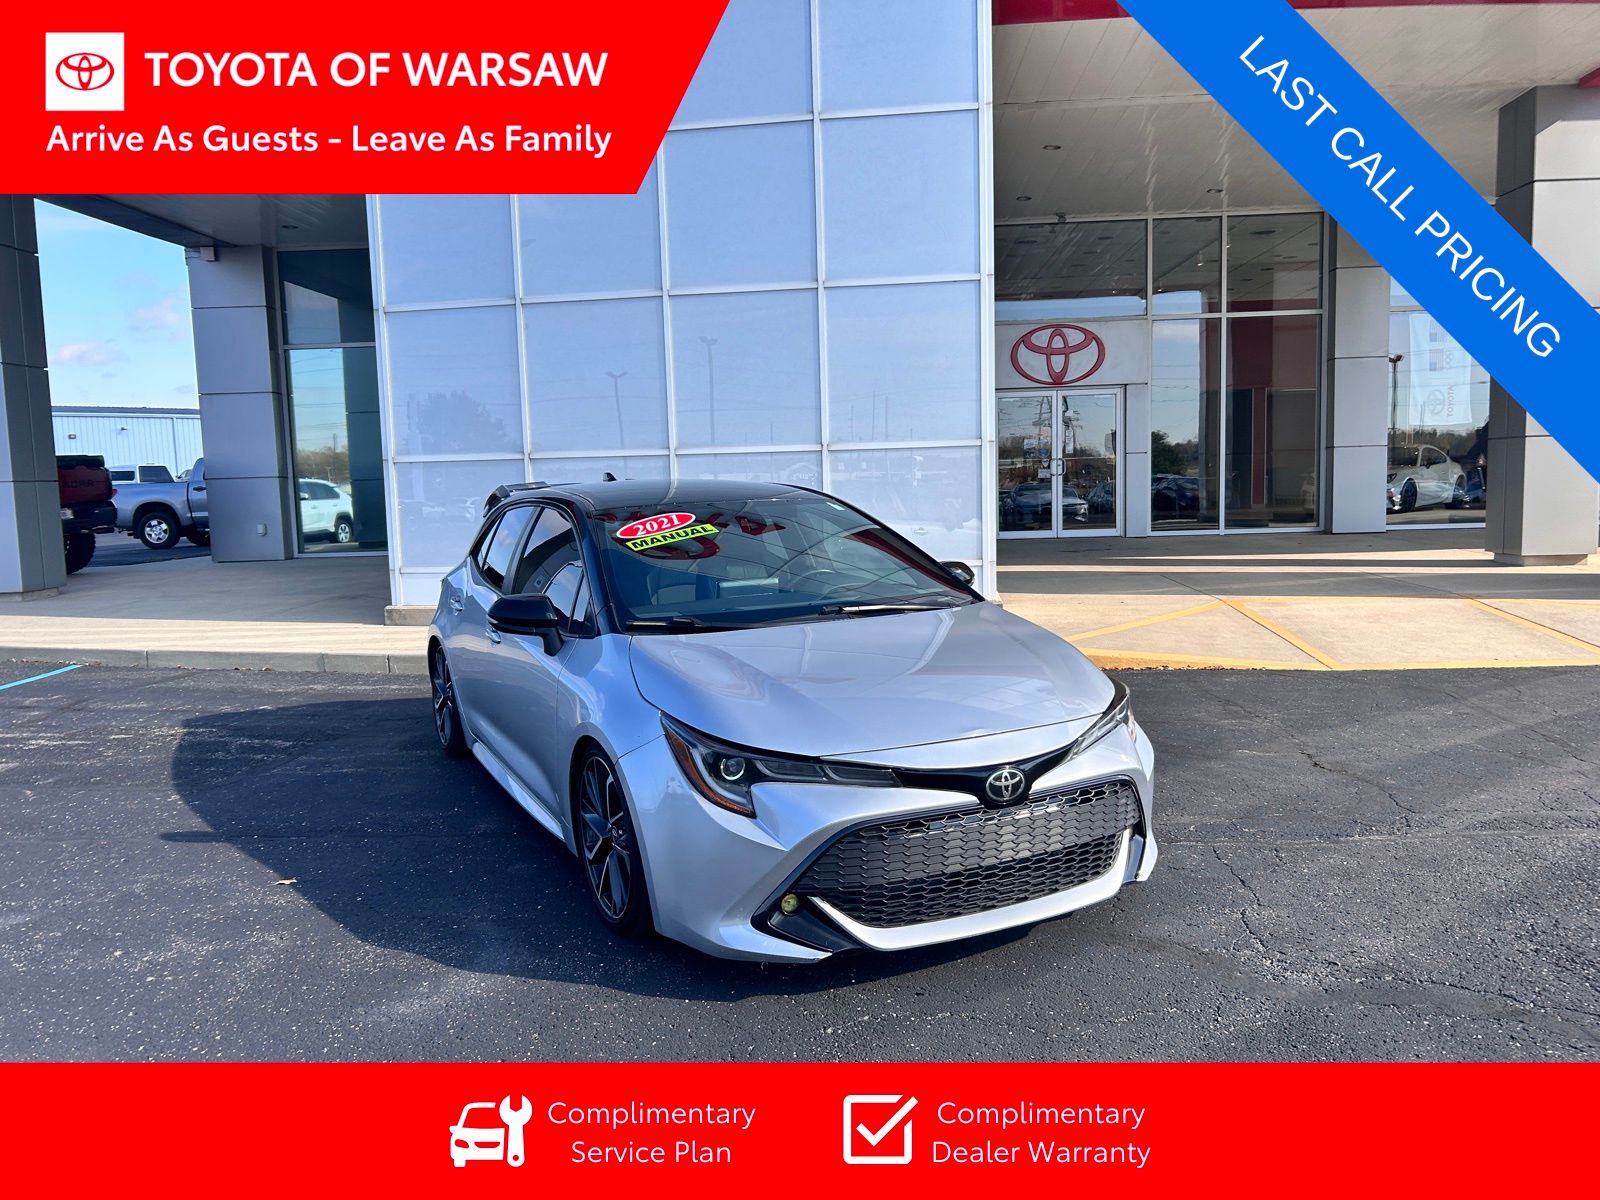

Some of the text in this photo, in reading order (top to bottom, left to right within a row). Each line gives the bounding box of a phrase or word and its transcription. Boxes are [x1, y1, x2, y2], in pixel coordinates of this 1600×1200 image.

[1447, 384, 1456, 418] TOYOTA
[633, 514, 681, 536] 2021
[631, 526, 714, 549] MANUAL
